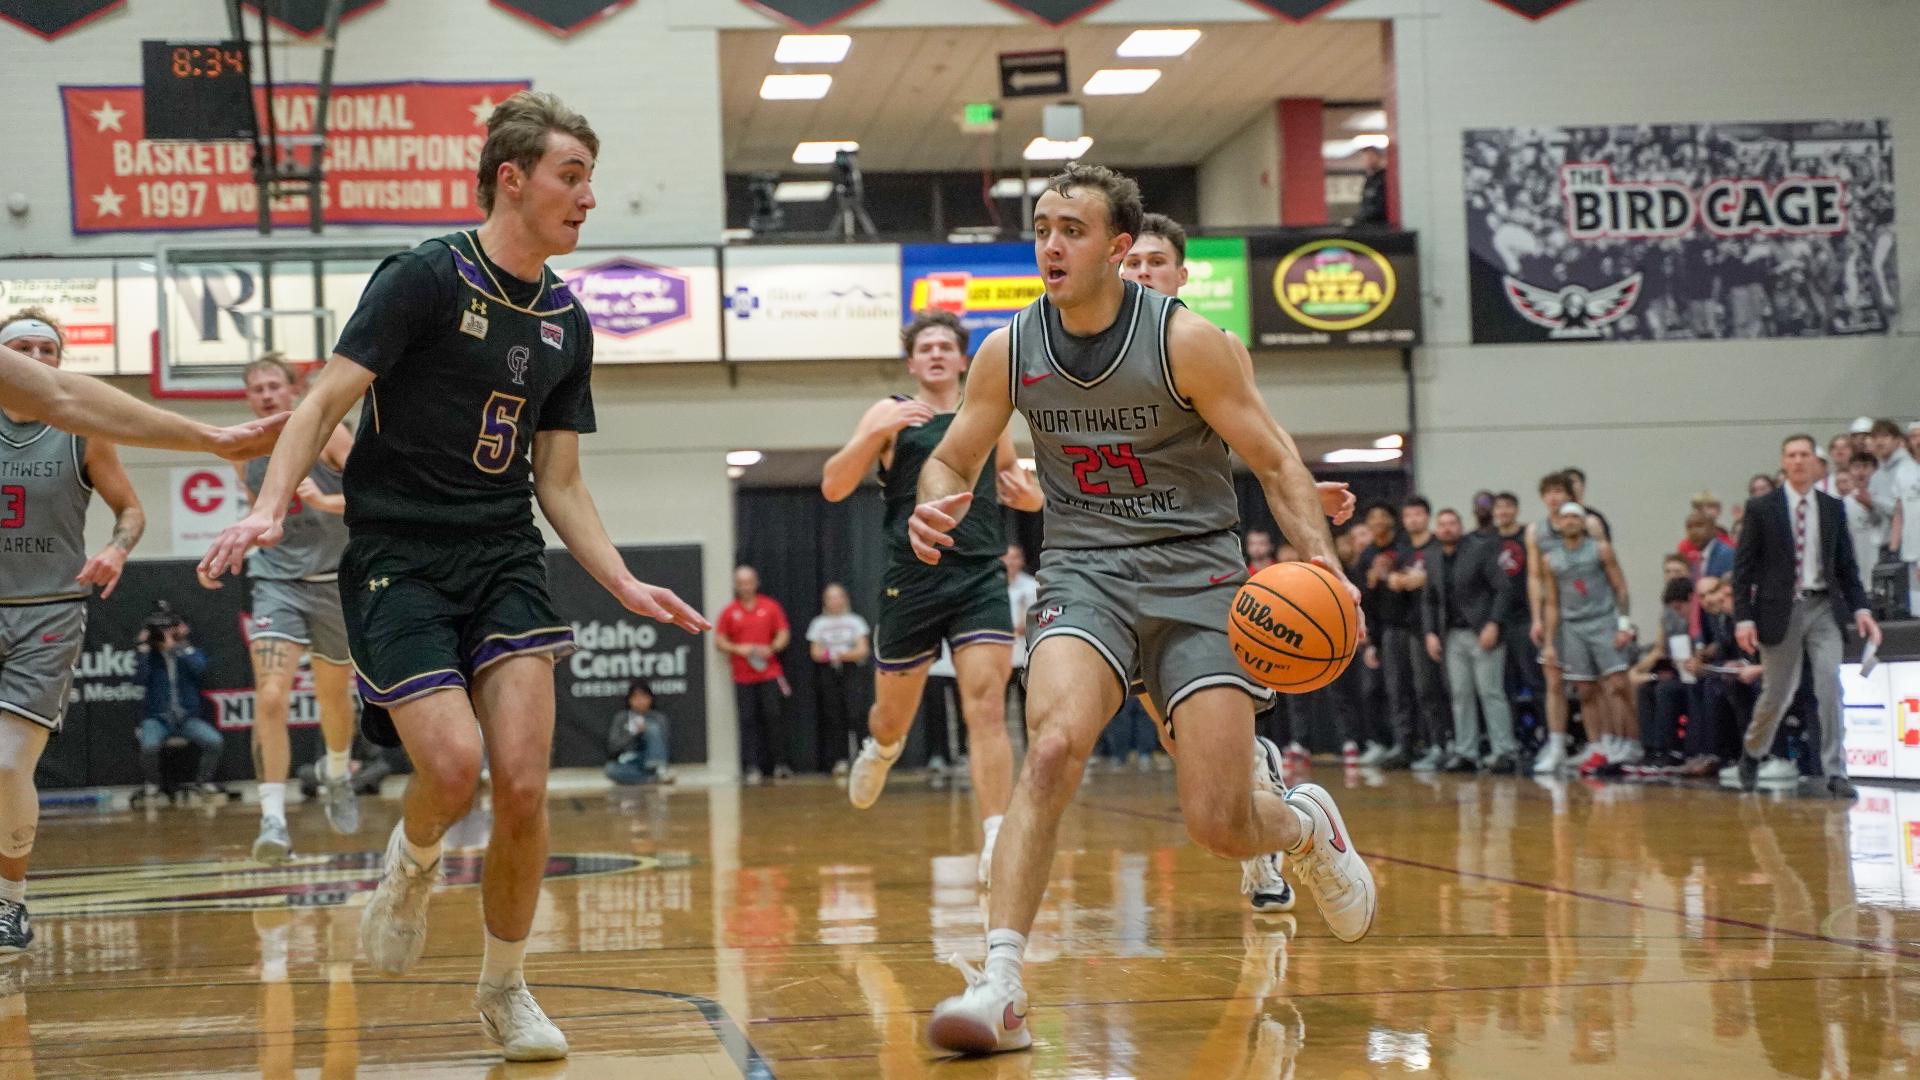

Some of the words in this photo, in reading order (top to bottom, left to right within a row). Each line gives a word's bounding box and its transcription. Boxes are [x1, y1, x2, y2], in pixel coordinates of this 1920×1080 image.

[172, 47, 243, 78] 8:34
[113, 138, 256, 177] BASKETB
[1569, 168, 1604, 186] THE
[139, 181, 207, 217] 1997
[340, 180, 443, 210] DIVISION
[1575, 190, 1690, 231] BIRD
[1706, 185, 1839, 228] CAGE
[1287, 281, 1382, 305] PIZZA
[473, 390, 526, 474] 5
[1028, 404, 1160, 432] NORTHWEST
[1060, 442, 1149, 495] 24
[1, 485, 26, 529] 3
[0, 537, 56, 553] ARENE
[572, 620, 656, 650] Idaho
[1236, 590, 1304, 650] Wilson
[570, 646, 690, 679] Central
